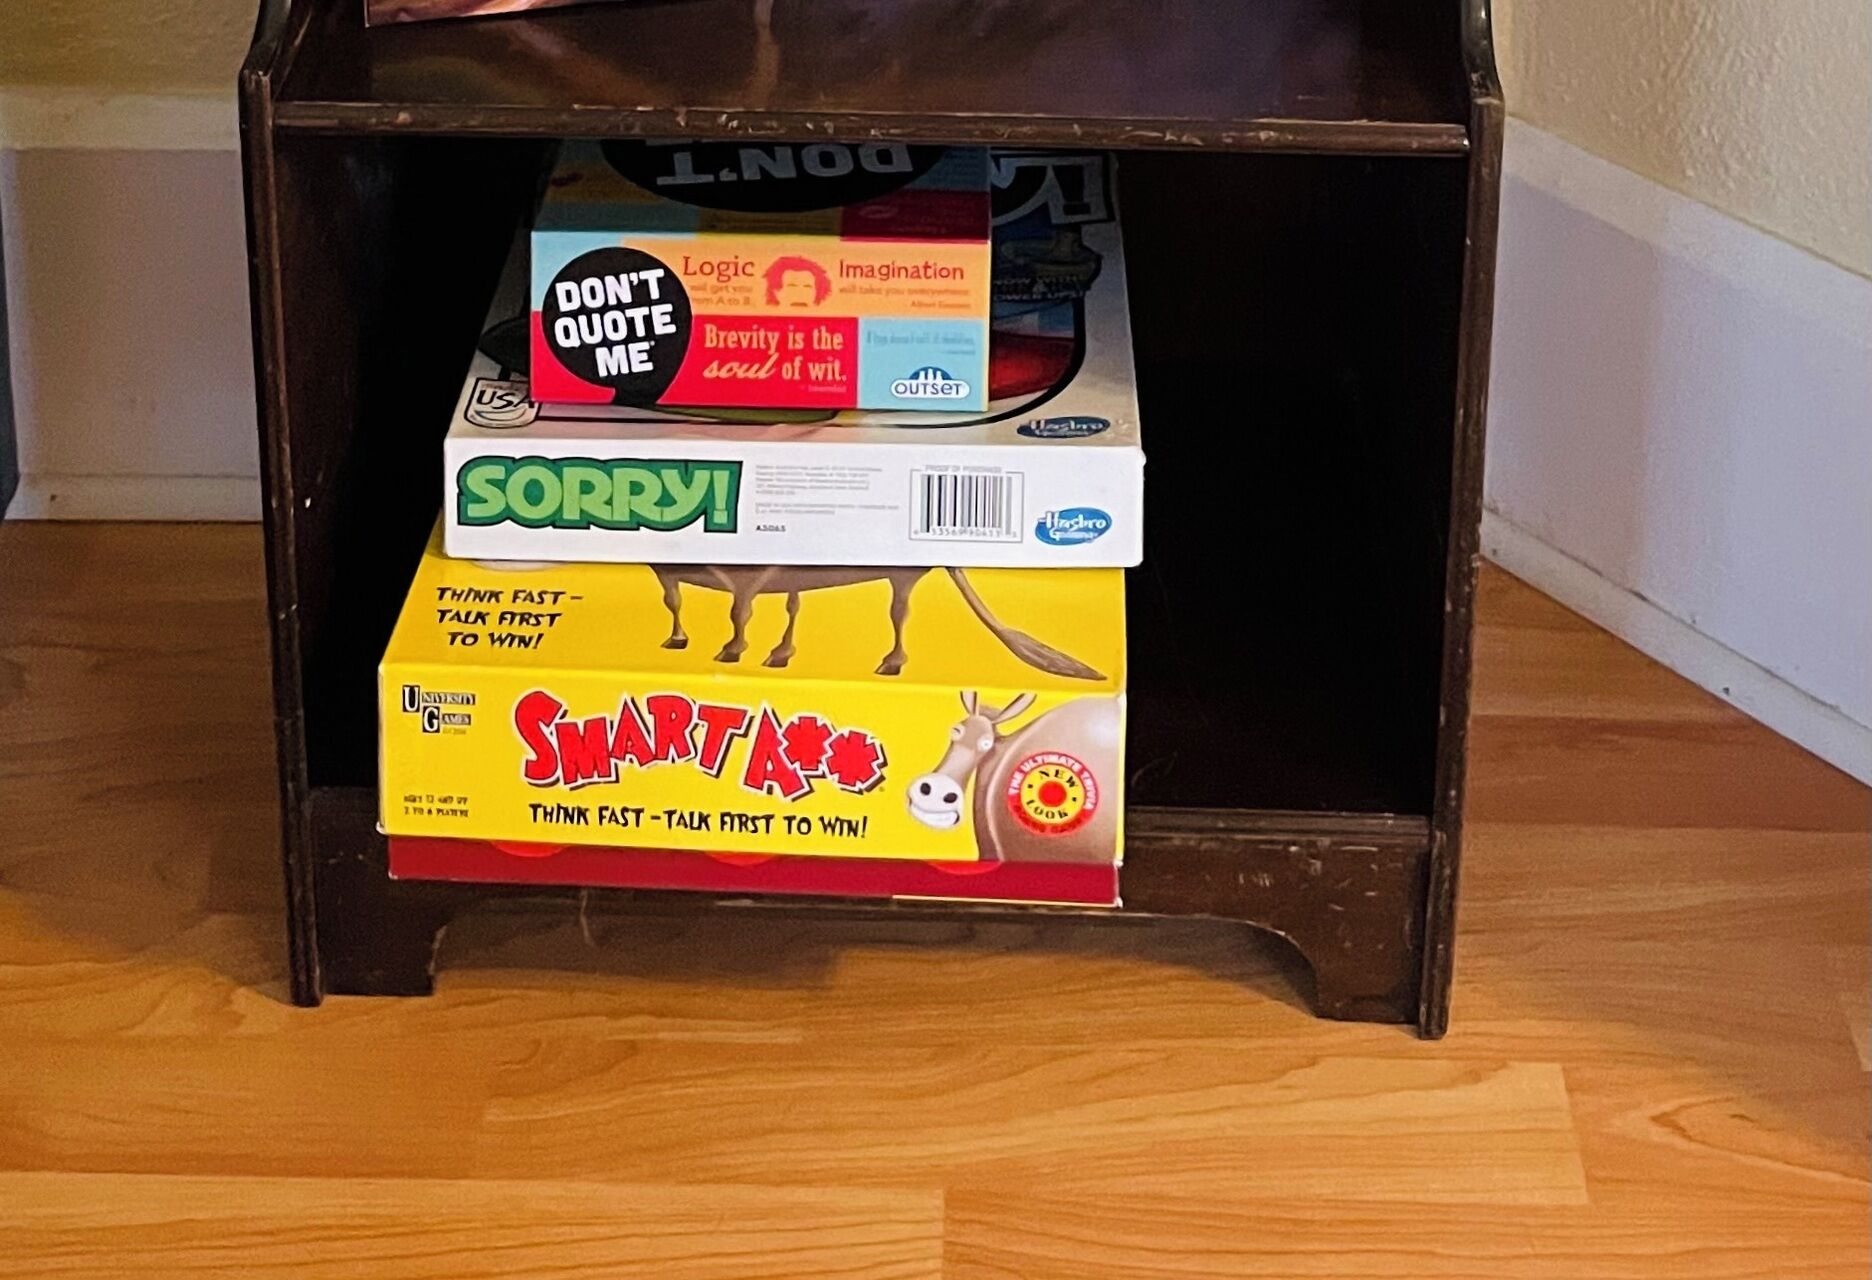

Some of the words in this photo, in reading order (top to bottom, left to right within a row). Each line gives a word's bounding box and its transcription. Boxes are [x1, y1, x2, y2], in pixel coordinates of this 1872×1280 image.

[656, 142, 913, 185] DON'T
[682, 254, 755, 284] Logic
[838, 259, 965, 282] Imagination
[555, 267, 666, 313] DON'T
[553, 303, 678, 349] QUOTE
[703, 324, 779, 356] Brevity
[787, 327, 805, 351] is
[811, 326, 844, 351] the
[594, 342, 655, 378] ME
[702, 352, 779, 380] soul
[781, 356, 803, 380] of
[808, 358, 848, 383] wit.
[464, 463, 731, 526] SORRY!
[1038, 511, 1107, 530] Hasbro
[436, 586, 504, 603] THINK
[511, 590, 567, 606] FAST
[436, 609, 492, 627] TALK
[498, 611, 562, 628] FIRST
[448, 631, 480, 647] TO
[488, 632, 545, 650] WIN!
[403, 685, 476, 713] UNIVERSITY
[422, 706, 471, 733] GAMES
[512, 688, 751, 790] SMART
[1007, 771, 1026, 796] THE
[1020, 753, 1084, 775] ULTIMATE
[1039, 768, 1080, 788] NEW
[528, 803, 590, 826] THINK
[598, 806, 645, 829] FAST
[663, 809, 711, 832] TALK
[719, 812, 775, 835] FIRST
[783, 815, 813, 836] TO
[817, 815, 869, 839] WIN!
[1025, 799, 1069, 819] LOOK
